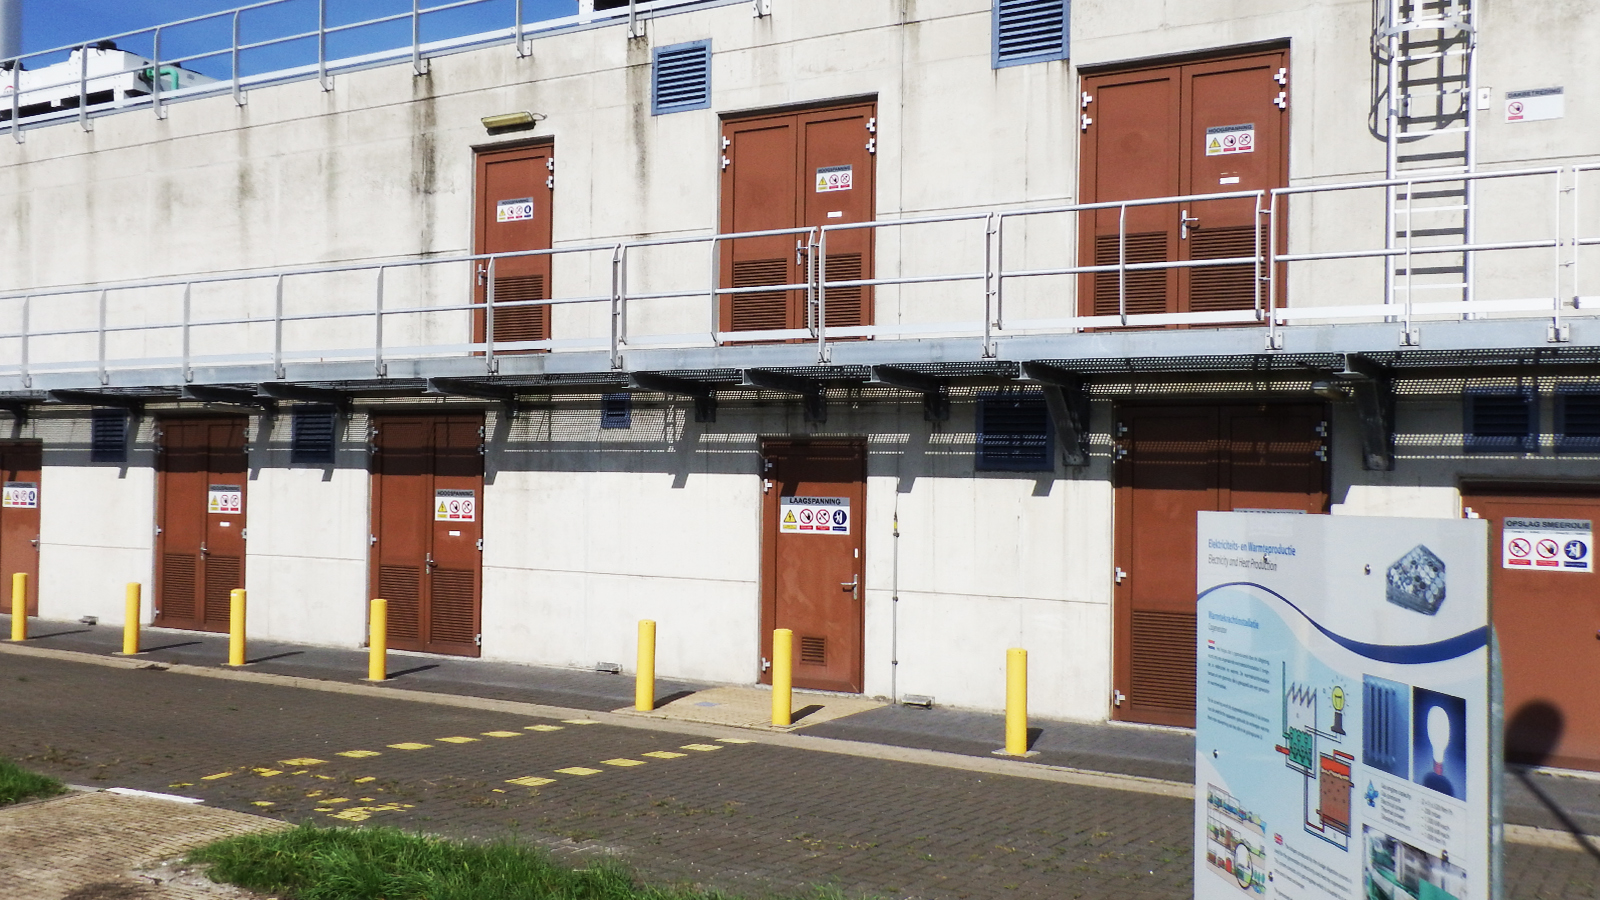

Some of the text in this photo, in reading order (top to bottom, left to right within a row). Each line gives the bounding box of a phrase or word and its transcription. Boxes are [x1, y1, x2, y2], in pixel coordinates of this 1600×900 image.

[1208, 124, 1252, 133] HOOGSPANNING
[789, 497, 841, 505] LAAGSPANNING
[1506, 520, 1590, 529] OPSLAG SMEEROLIE
[1240, 543, 1247, 551] en
[1247, 542, 1296, 556] Warmteproductie
[1208, 553, 1277, 571] Electricity and Heat Production
